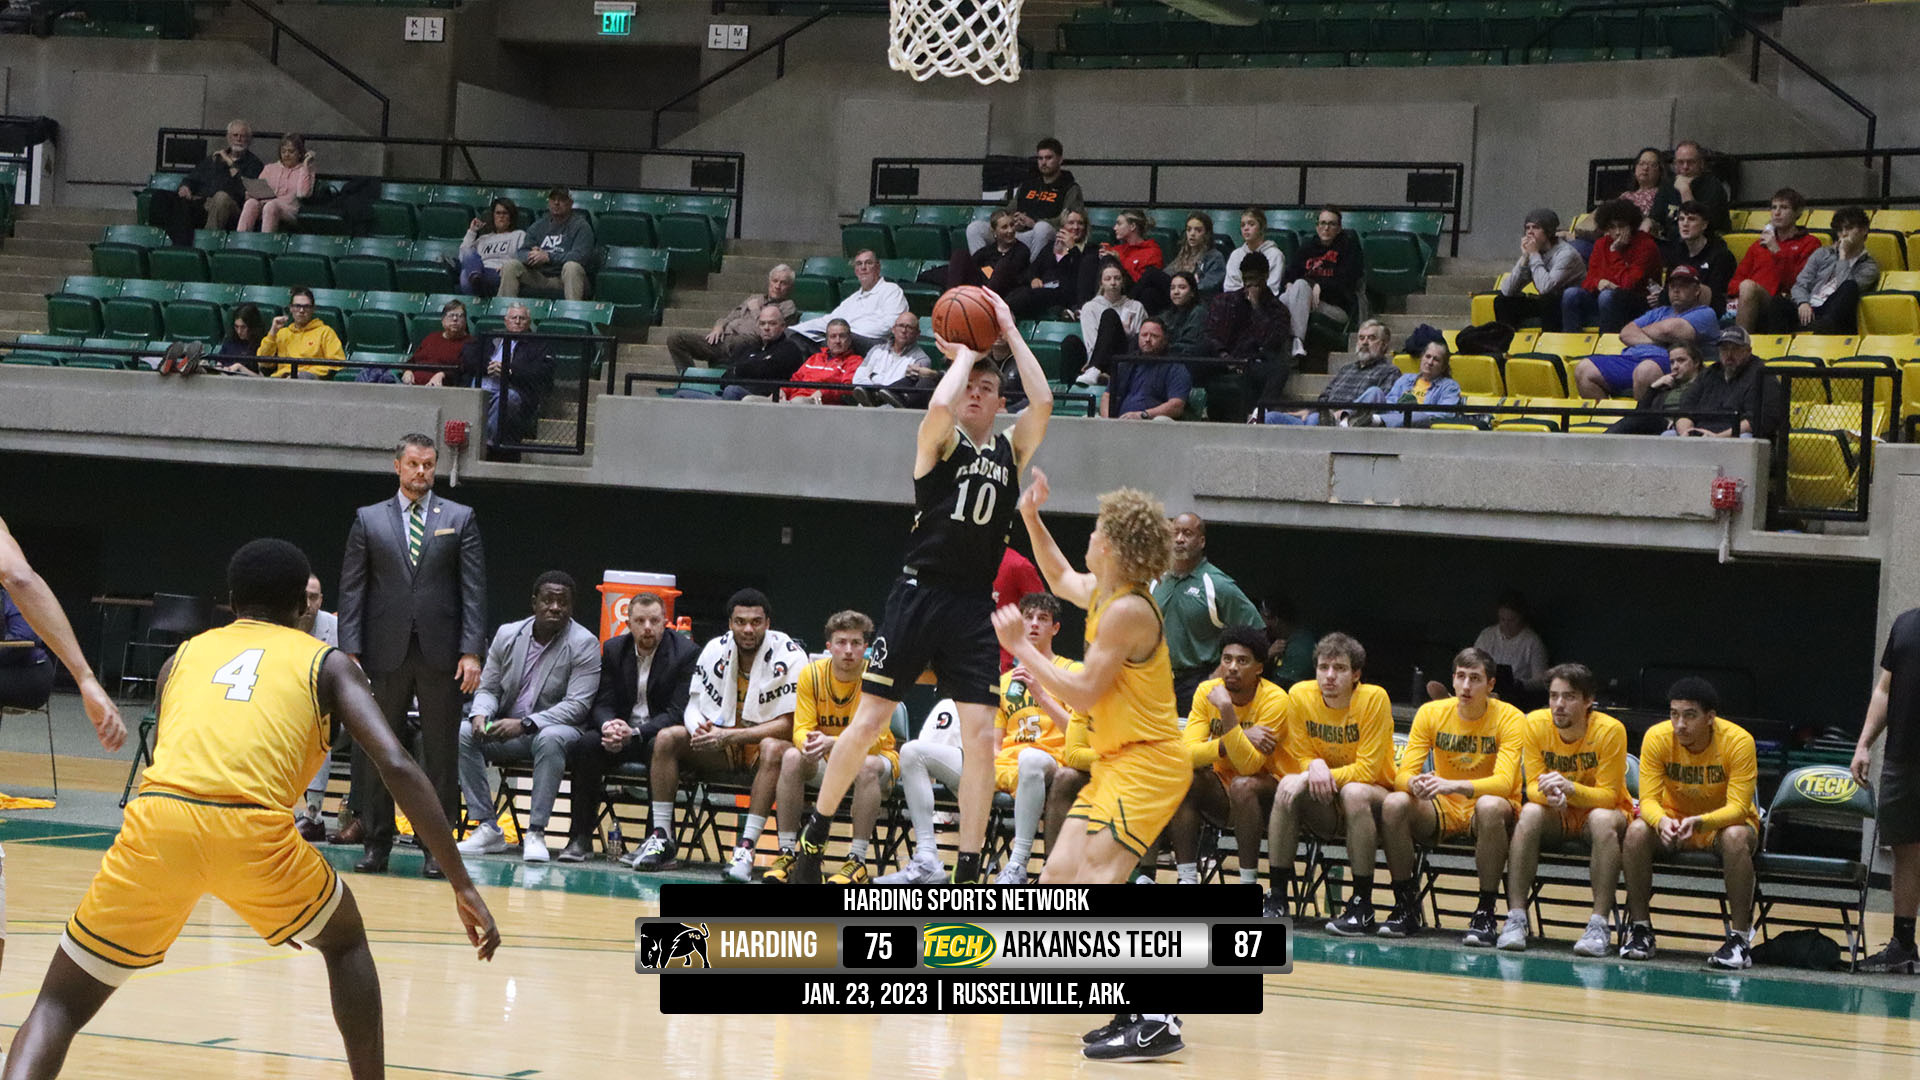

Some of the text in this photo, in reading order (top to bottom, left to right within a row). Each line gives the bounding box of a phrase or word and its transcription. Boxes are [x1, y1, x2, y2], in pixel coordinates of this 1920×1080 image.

[411, 20, 437, 28] K L
[602, 12, 627, 33] EXIT
[715, 28, 743, 36] L M
[950, 479, 997, 526] 10
[211, 648, 266, 702] 4
[1806, 776, 1850, 793] TECH
